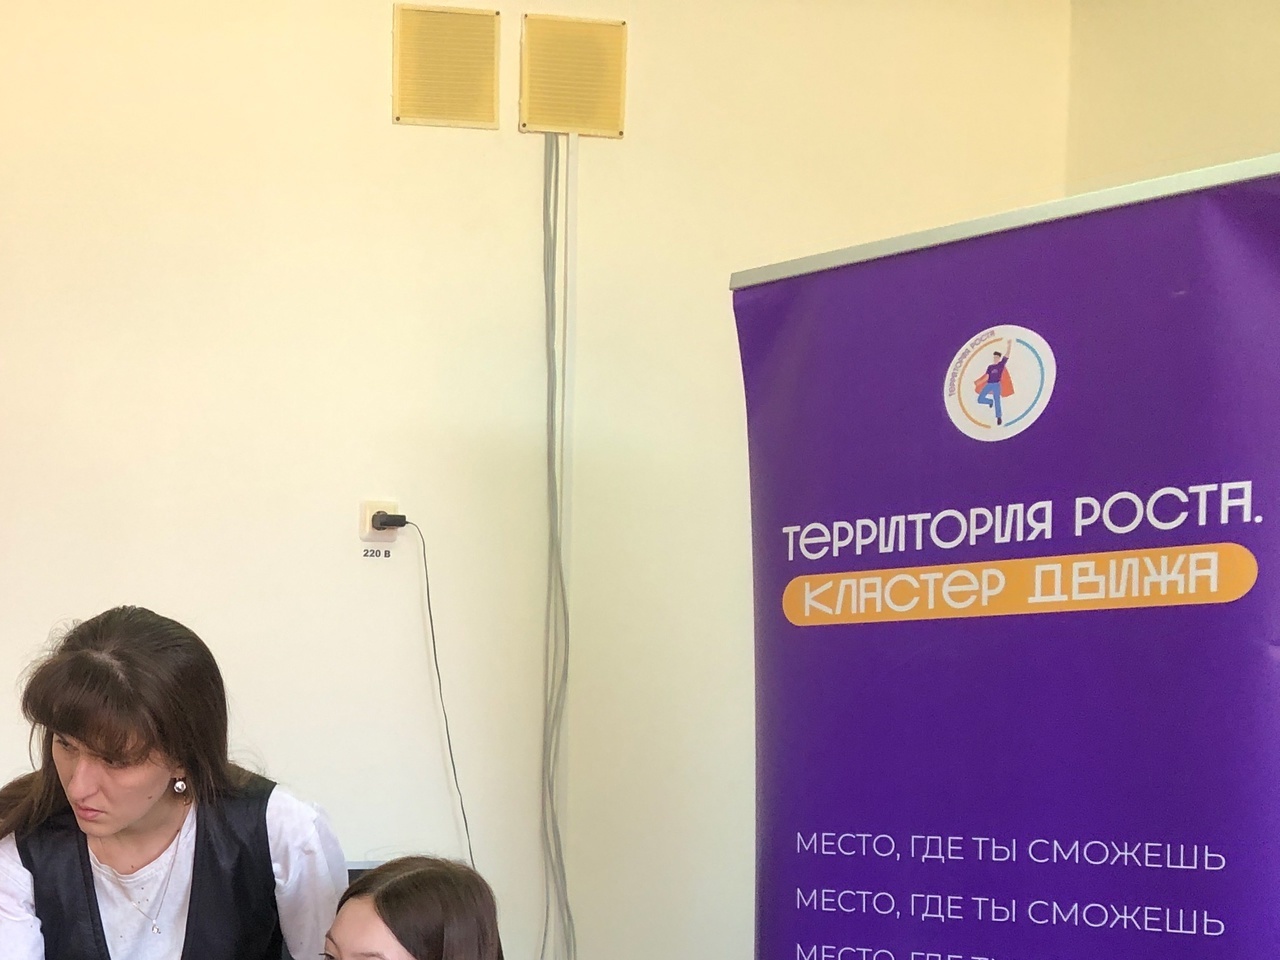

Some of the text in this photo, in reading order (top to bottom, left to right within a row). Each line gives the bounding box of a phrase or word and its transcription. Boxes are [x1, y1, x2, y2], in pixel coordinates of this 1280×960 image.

[783, 480, 1263, 561] ТЕРРИТОРИЯ РОСТА.
[363, 549, 381, 557] 220
[804, 551, 1219, 616] КЛАСТЕР ДВИЖА
[797, 832, 1226, 871] МЕСТО, ГДЕ ТЫ СМОЖЕШЬ
[797, 887, 1226, 936] МЕСТО, ГДЕ ТЫ СМОЖЕШЬ
